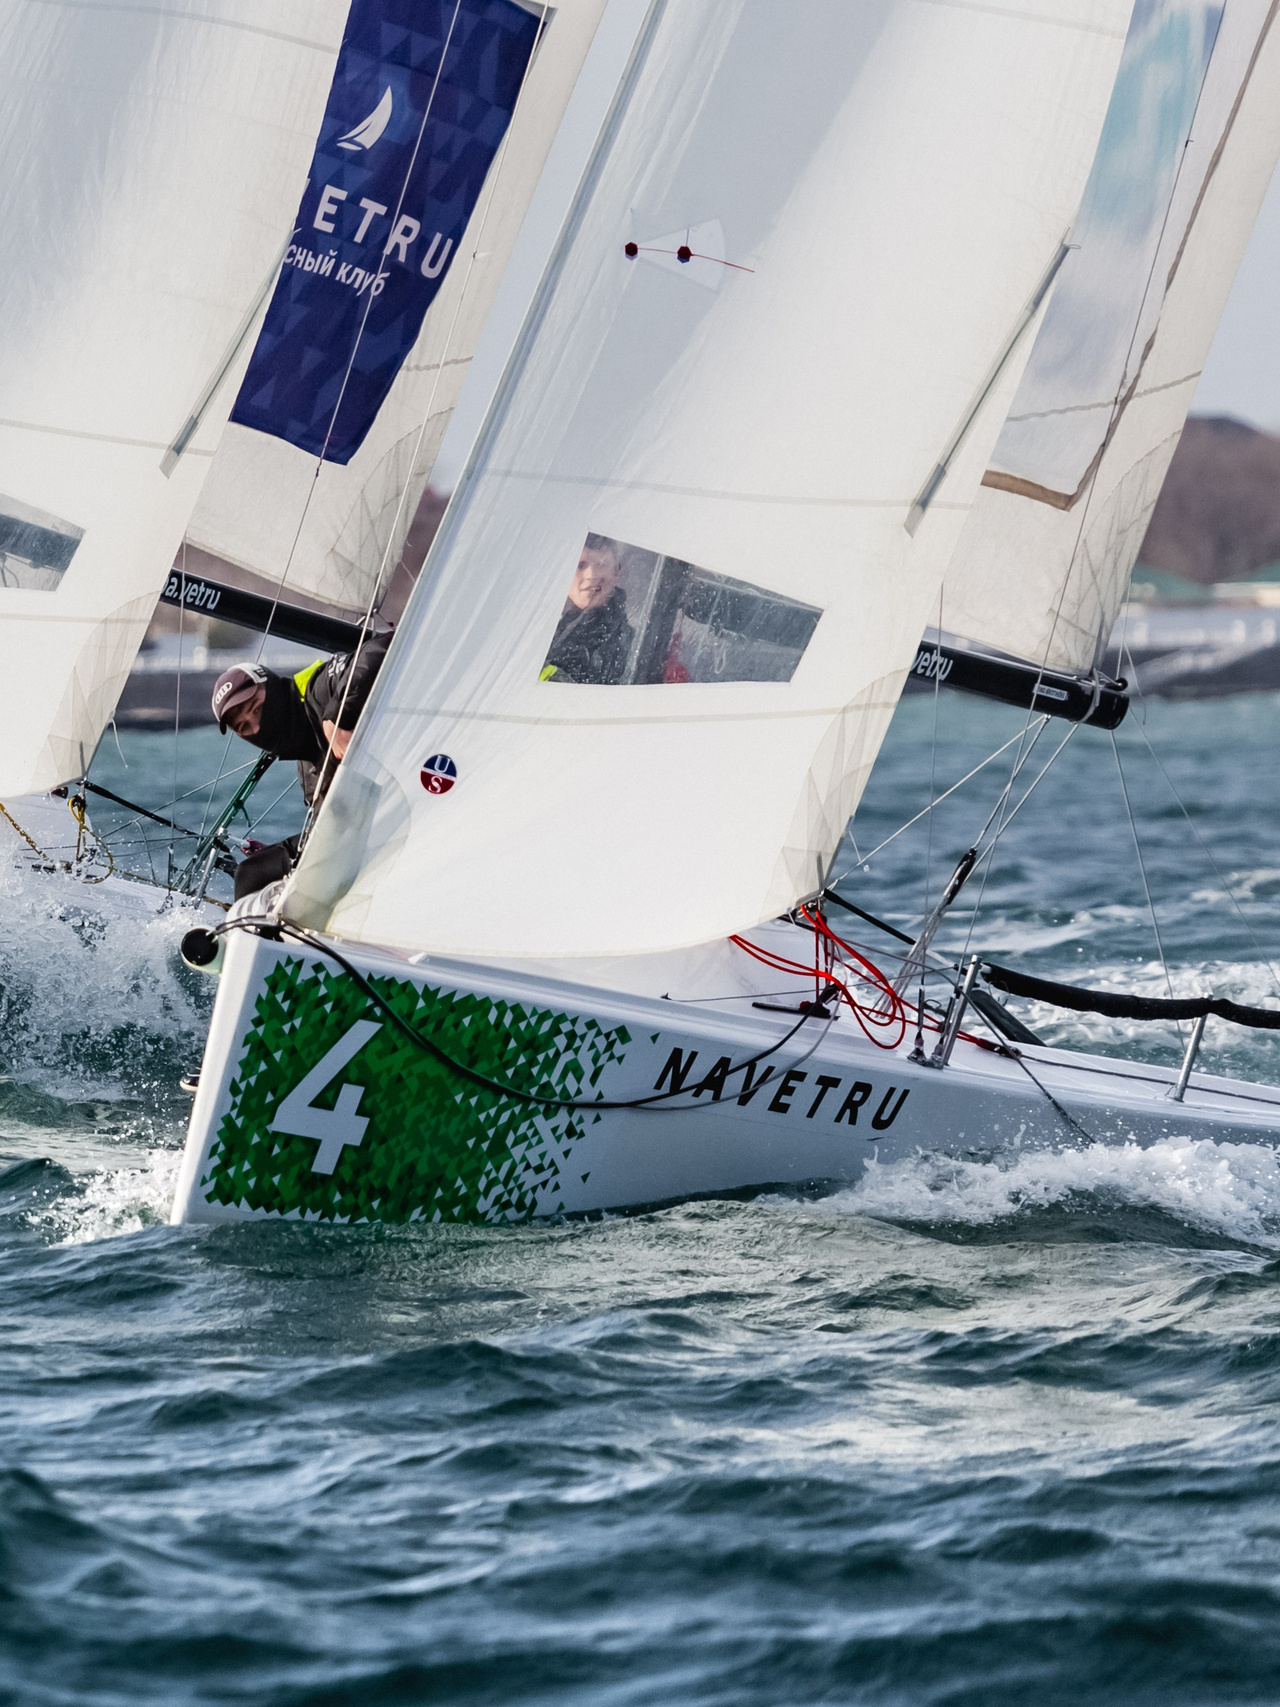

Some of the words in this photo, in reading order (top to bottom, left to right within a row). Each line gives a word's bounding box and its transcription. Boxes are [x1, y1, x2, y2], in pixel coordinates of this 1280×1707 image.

[301, 178, 453, 279] ETRU
[283, 244, 338, 277] сный
[335, 262, 391, 297] клуб
[428, 775, 443, 793] S
[434, 755, 451, 773] U
[271, 1019, 384, 1175] 4
[653, 1047, 910, 1131] NAVETRU
